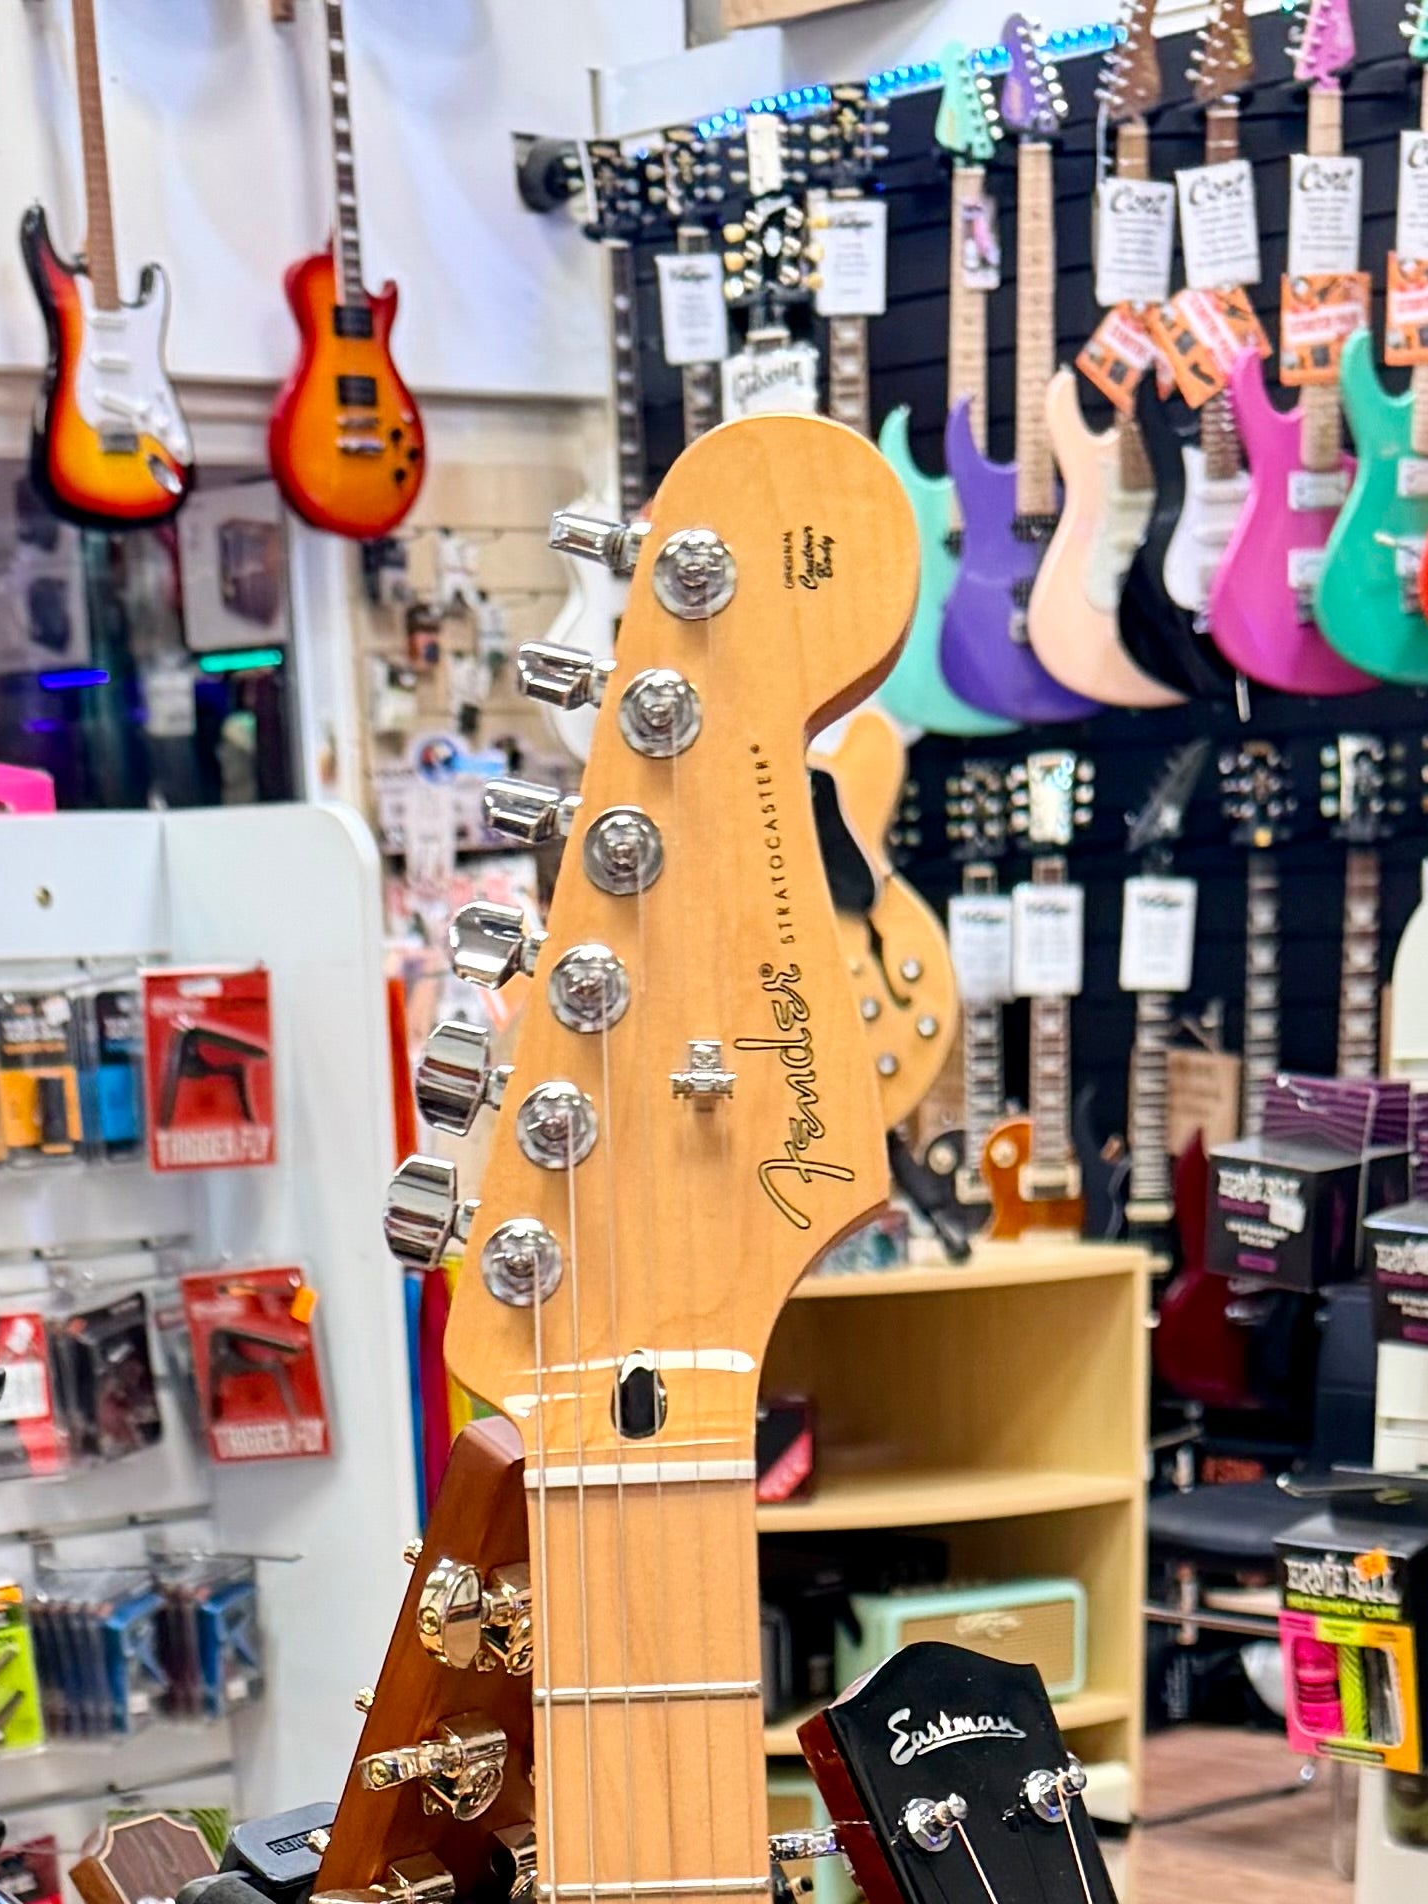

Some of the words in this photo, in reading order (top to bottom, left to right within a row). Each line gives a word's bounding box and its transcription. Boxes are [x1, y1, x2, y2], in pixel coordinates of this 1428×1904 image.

[1298, 162, 1354, 192] Cort
[1109, 186, 1168, 215] Cort
[887, 1707, 1028, 1766] Eastman
